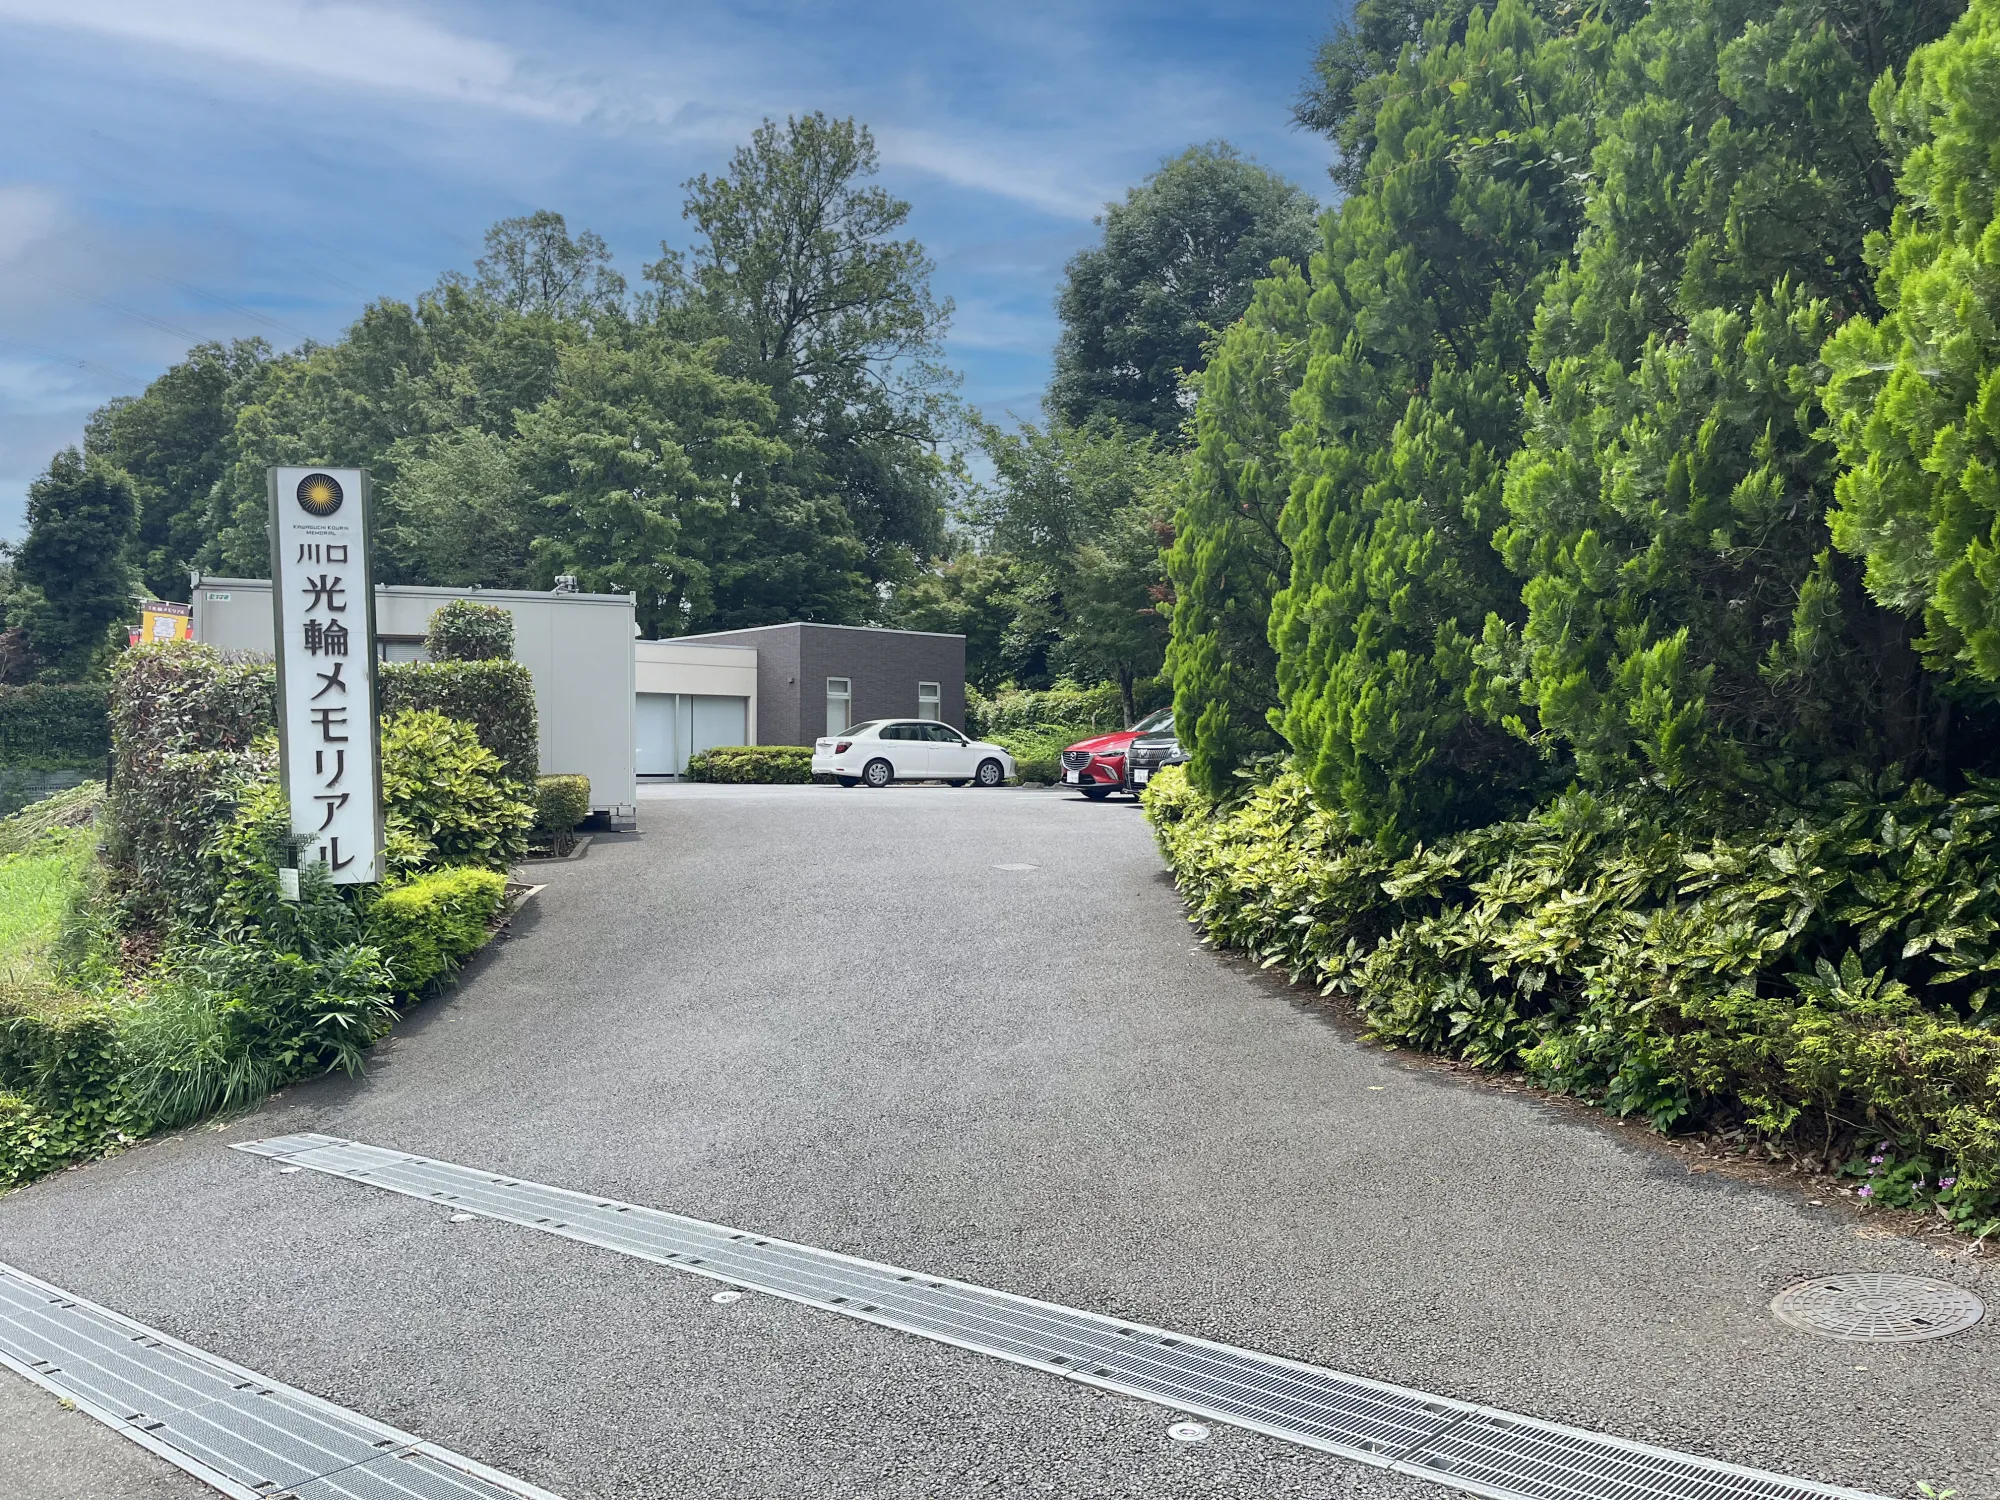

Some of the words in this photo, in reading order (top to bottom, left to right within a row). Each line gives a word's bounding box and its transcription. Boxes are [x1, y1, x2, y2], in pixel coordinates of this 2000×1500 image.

[296, 543, 348, 564] 川口
[301, 574, 355, 872] 光輪メモリアル
